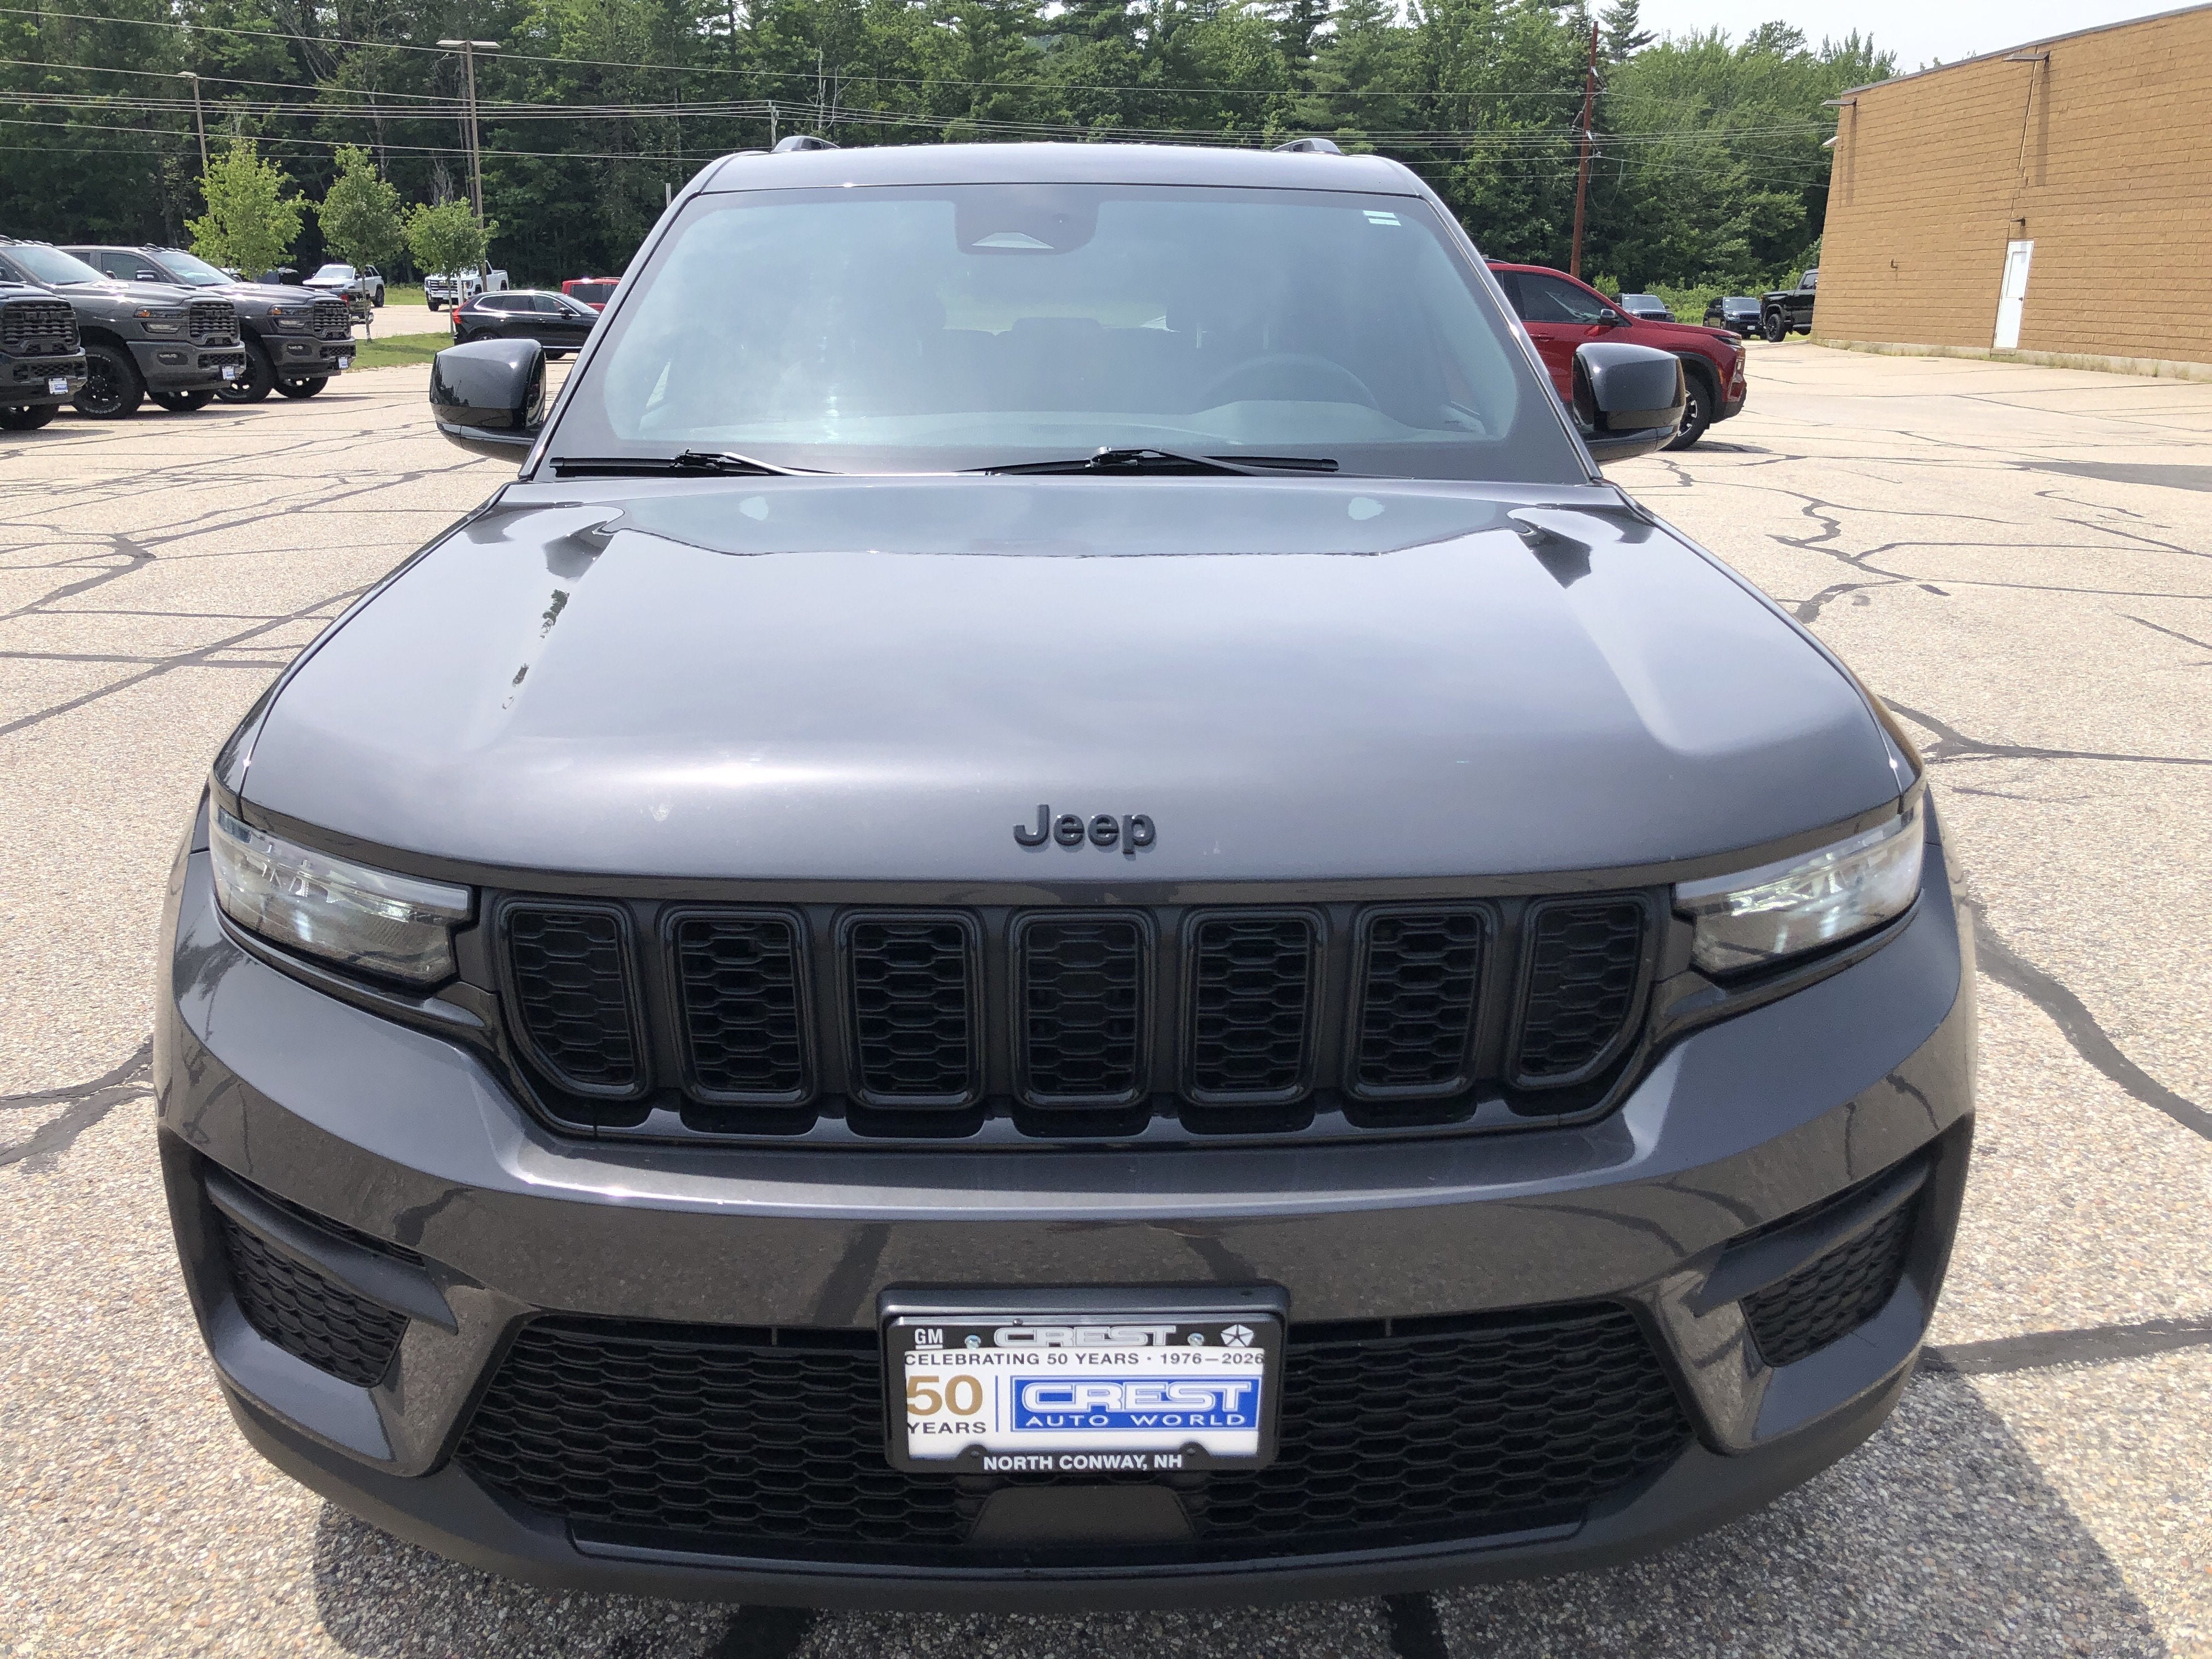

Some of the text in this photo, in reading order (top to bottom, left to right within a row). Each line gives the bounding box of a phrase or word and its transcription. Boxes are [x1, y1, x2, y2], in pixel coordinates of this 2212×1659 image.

[1013, 804, 1155, 855] Jeep
[915, 1328, 943, 1344] GM
[994, 1326, 1177, 1347] CREST
[905, 1353, 1040, 1365] CELEBRATING
[1047, 1353, 1068, 1364] 50
[1075, 1353, 1139, 1364] YEARS
[907, 1374, 983, 1416] 50
[1022, 1381, 1252, 1413] CREST
[907, 1421, 986, 1434] YEARS
[1026, 1414, 1245, 1426] AUTO WORLD
[984, 1454, 1182, 1471] NORTH CONWAY, NH
